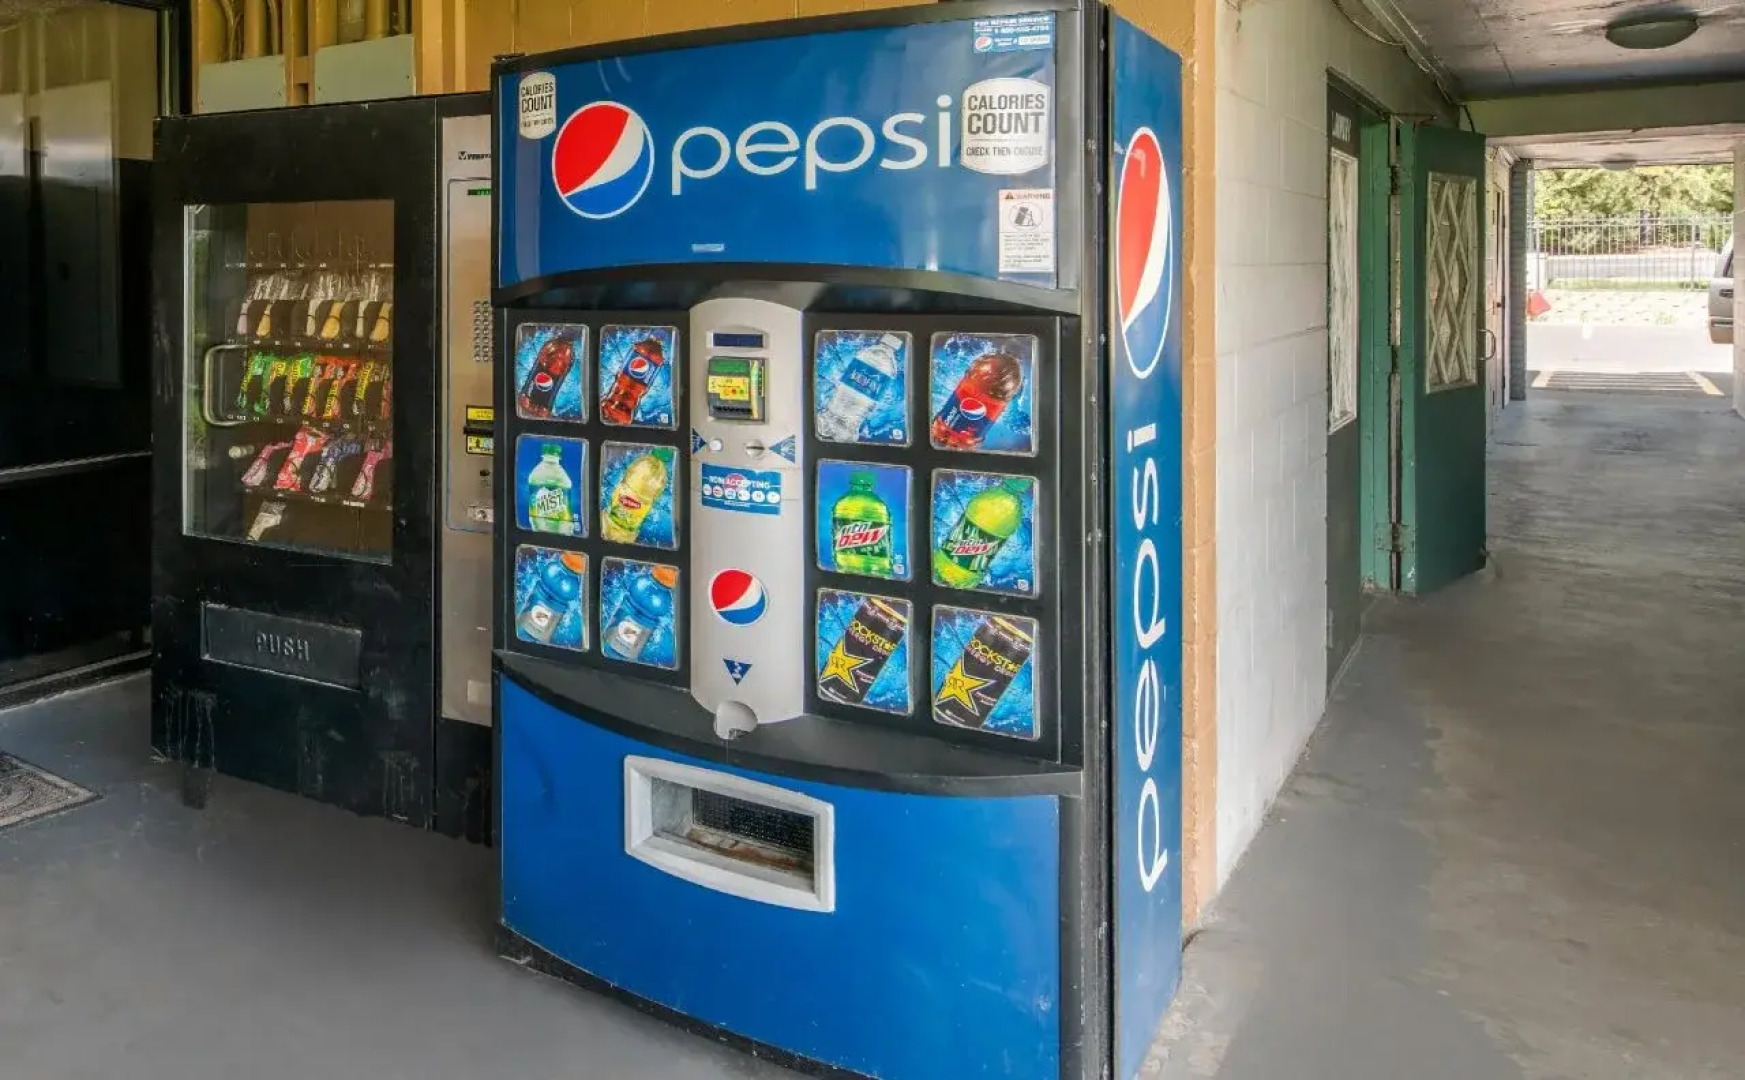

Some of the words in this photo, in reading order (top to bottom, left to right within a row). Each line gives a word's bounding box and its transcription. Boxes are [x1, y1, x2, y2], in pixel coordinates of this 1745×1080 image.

[521, 82, 554, 97] CALORIES
[521, 94, 553, 113] COUNT
[967, 93, 1045, 111] CALORIES
[967, 112, 1045, 134] COUNT
[671, 94, 953, 196] pepsi
[966, 146, 990, 156] CHECK
[992, 146, 1011, 156] THEN
[725, 478, 771, 489] ACCEPTING
[537, 494, 562, 511] MIST
[256, 630, 310, 663] PUSH
[1126, 422, 1167, 893] pepsi
